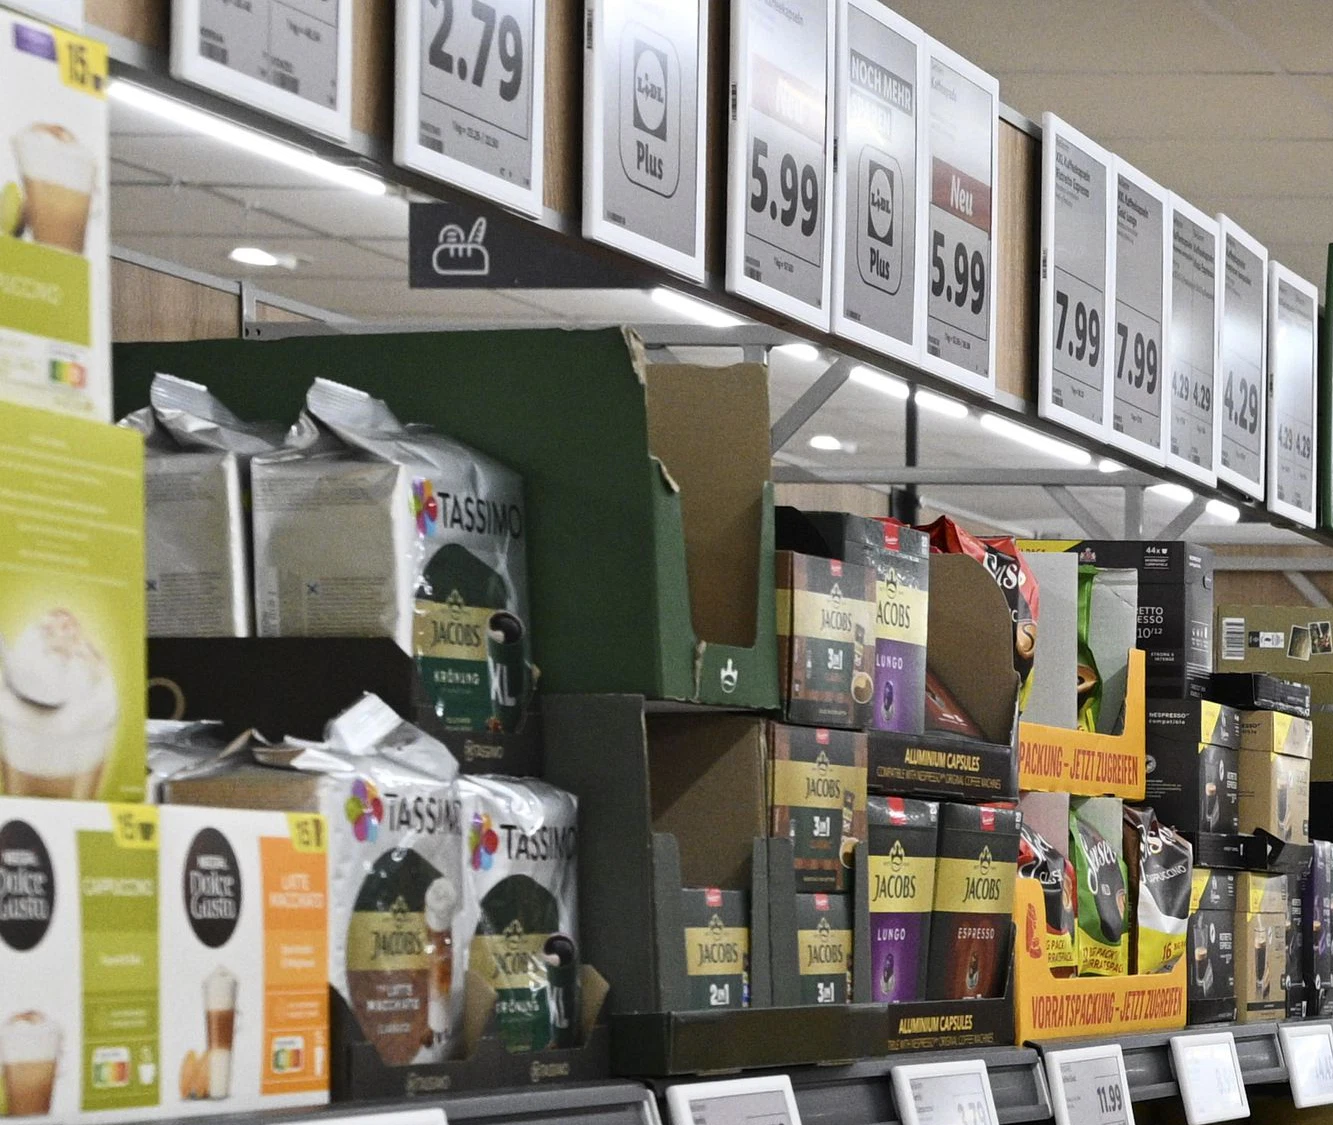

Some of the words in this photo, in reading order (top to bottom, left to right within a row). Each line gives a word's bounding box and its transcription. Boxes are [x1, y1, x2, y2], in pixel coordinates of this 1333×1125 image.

[429, 0, 523, 101] 2.79
[851, 56, 882, 93] NOCH
[884, 74, 912, 110] MEHR
[636, 140, 664, 181] Plus
[750, 136, 819, 237] 5.99
[951, 175, 973, 216] Neu
[870, 247, 890, 281] Plus
[932, 230, 985, 315] 5.99
[1056, 290, 1100, 368] 7.99
[1117, 322, 1158, 395] 7.99
[1224, 371, 1258, 434] 4.29
[437, 492, 523, 540] TASSIMO
[820, 608, 851, 633] JACOBS
[876, 601, 911, 630] ACOBS
[430, 620, 481, 648] JACOBS
[876, 653, 904, 671] LUNGO
[905, 748, 947, 769] ALUMINIUM
[947, 751, 980, 772] CAPSULES
[1020, 741, 1063, 779] PACKUNG
[1070, 745, 1095, 782] JETZT
[1097, 751, 1139, 787] ZUGREIFEN
[805, 777, 841, 800] JACOBS
[190, 870, 235, 897] Dolce
[872, 875, 916, 901] JACOBS
[963, 875, 1001, 902] JACOBS
[190, 897, 236, 920] Gusto
[877, 927, 906, 941] LUNGO
[958, 928, 995, 941] ESPRESSO
[698, 944, 738, 966] JACOBS
[808, 945, 843, 967] JACOBS
[1032, 991, 1116, 1030] VORRATSPACKUNG
[1119, 990, 1145, 1022] JETZT
[1144, 986, 1183, 1019] ZUGREIFEN
[899, 1016, 939, 1034] ALUMINIUM
[939, 1014, 973, 1031] CAPSULES
[1096, 1083, 1123, 1114] 11.99
